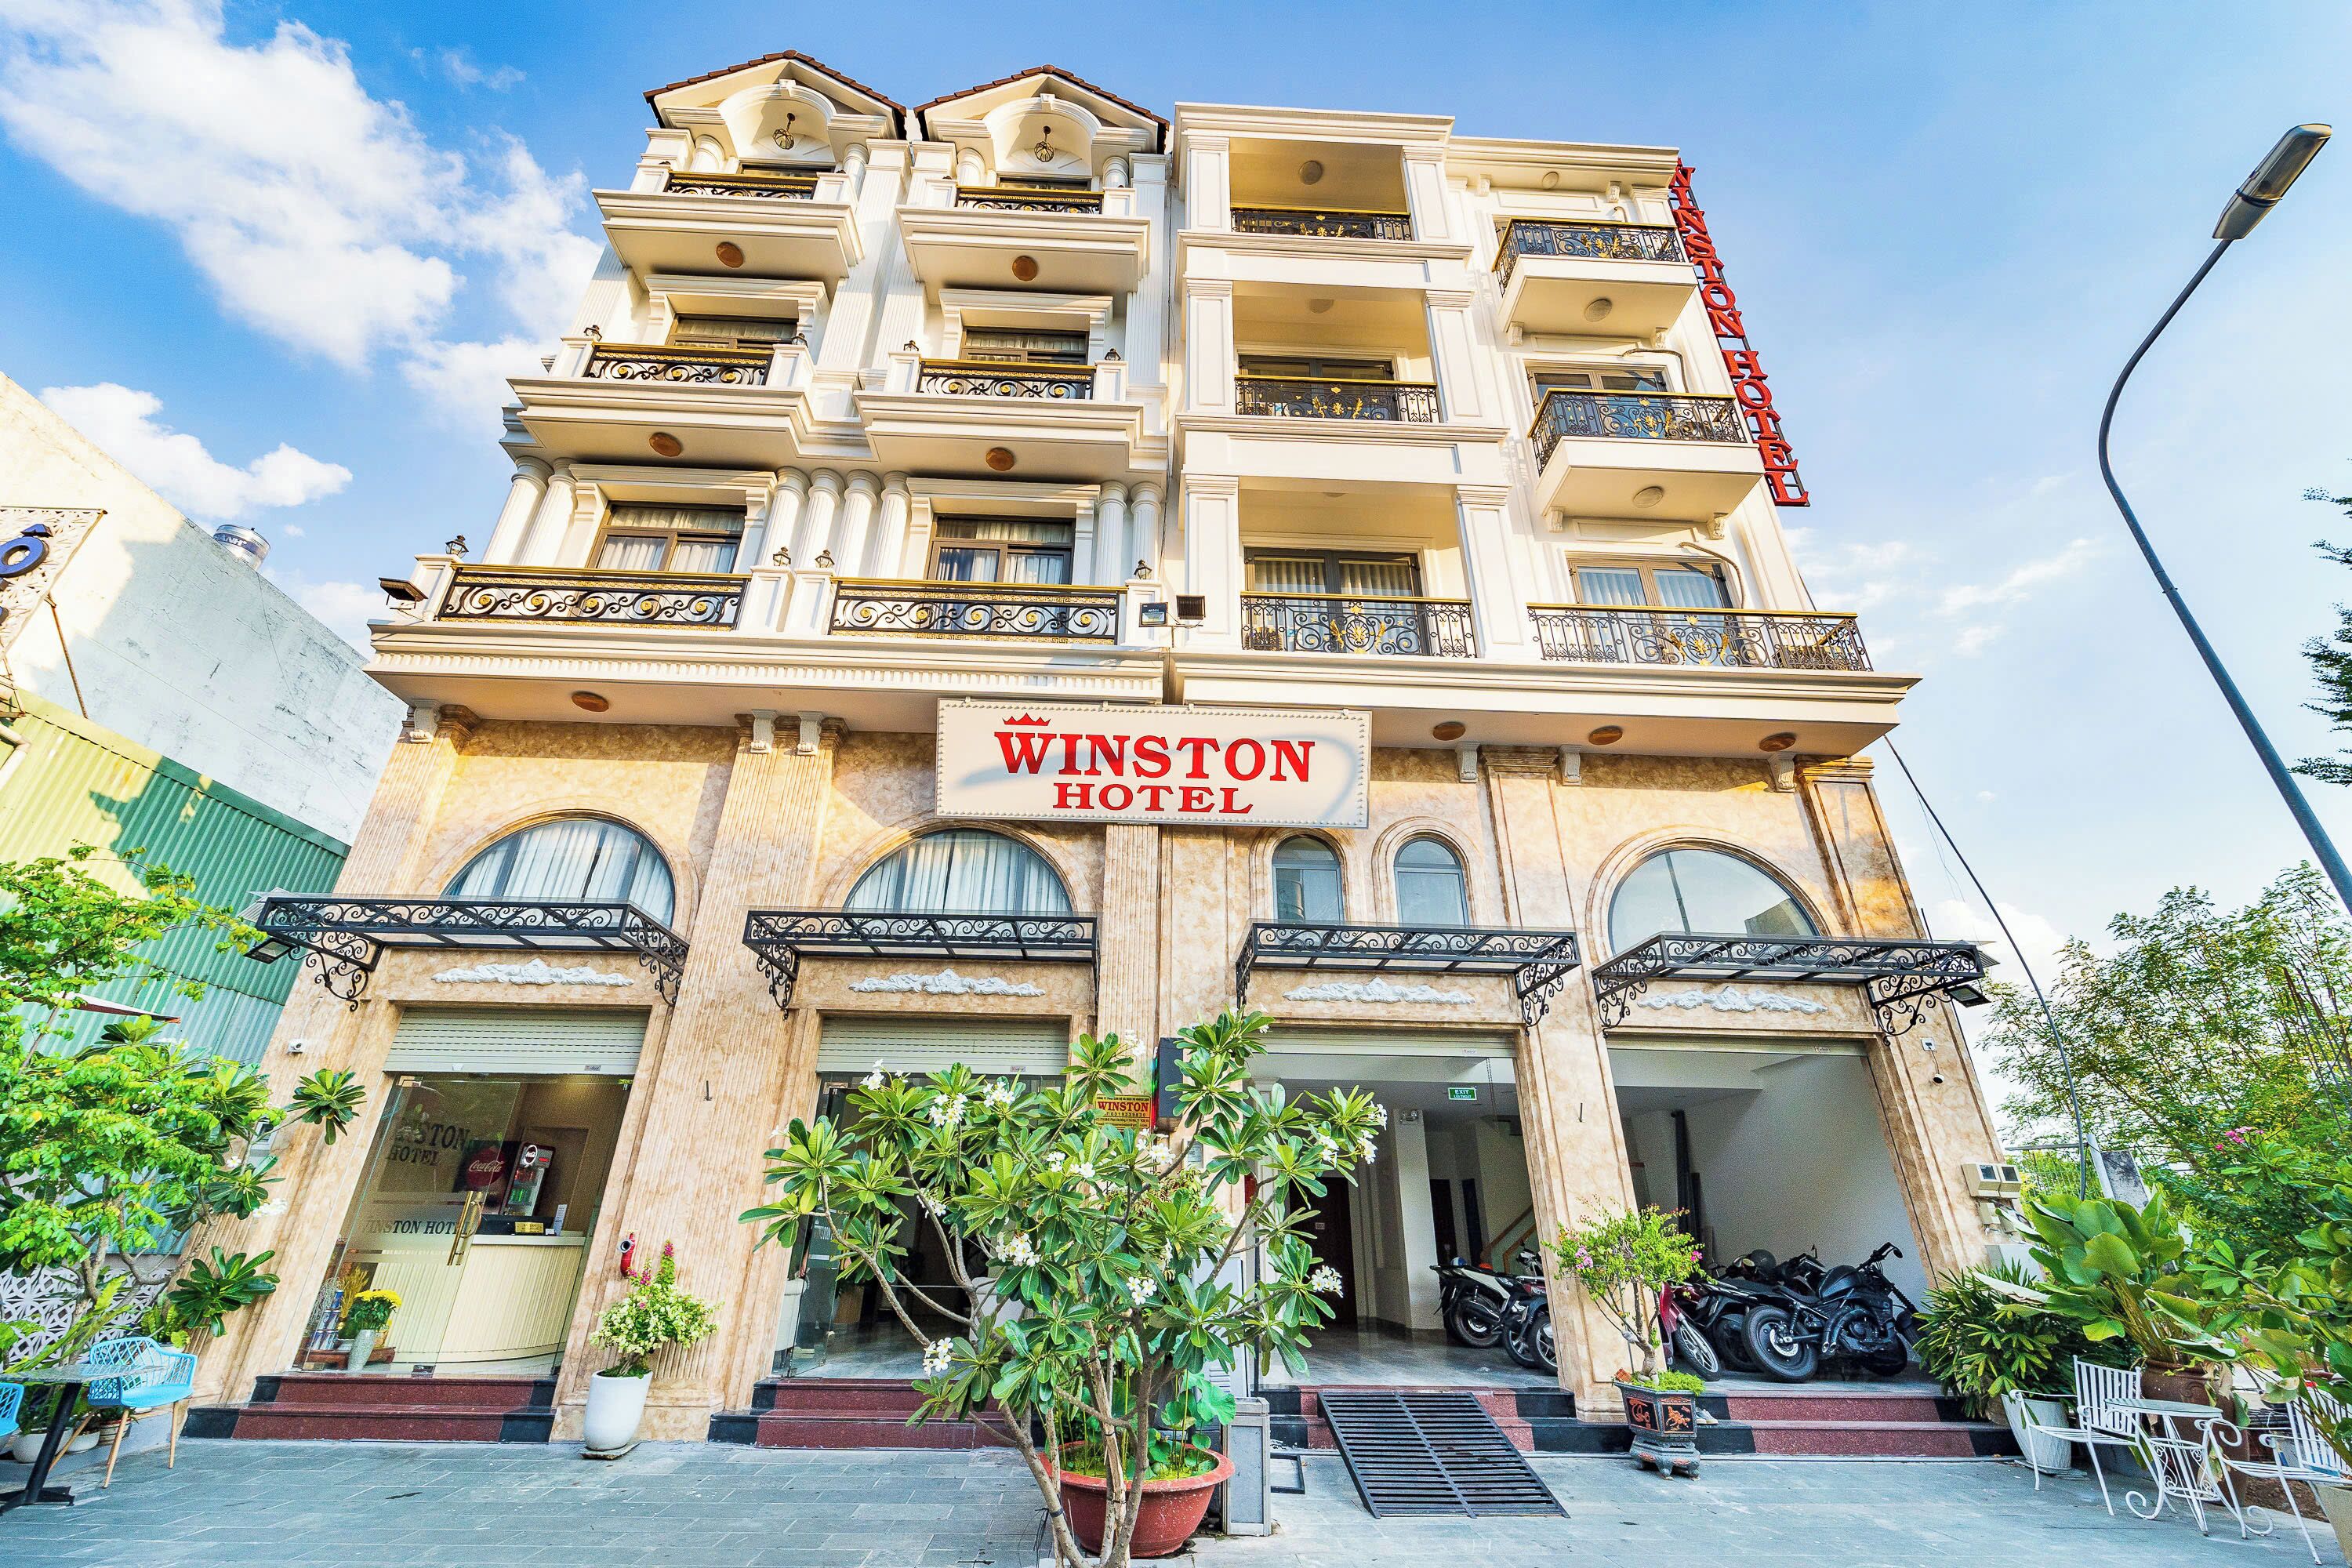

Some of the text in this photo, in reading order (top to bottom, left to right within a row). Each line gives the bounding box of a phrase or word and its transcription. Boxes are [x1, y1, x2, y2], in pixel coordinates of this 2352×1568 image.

[1668, 166, 1809, 506] WINSTON HOTEL
[994, 731, 1316, 782] WINSTON
[1053, 782, 1254, 814] HOTEL
[1098, 1102, 1149, 1112] WINSTON
[386, 1144, 439, 1167] HOTEL
